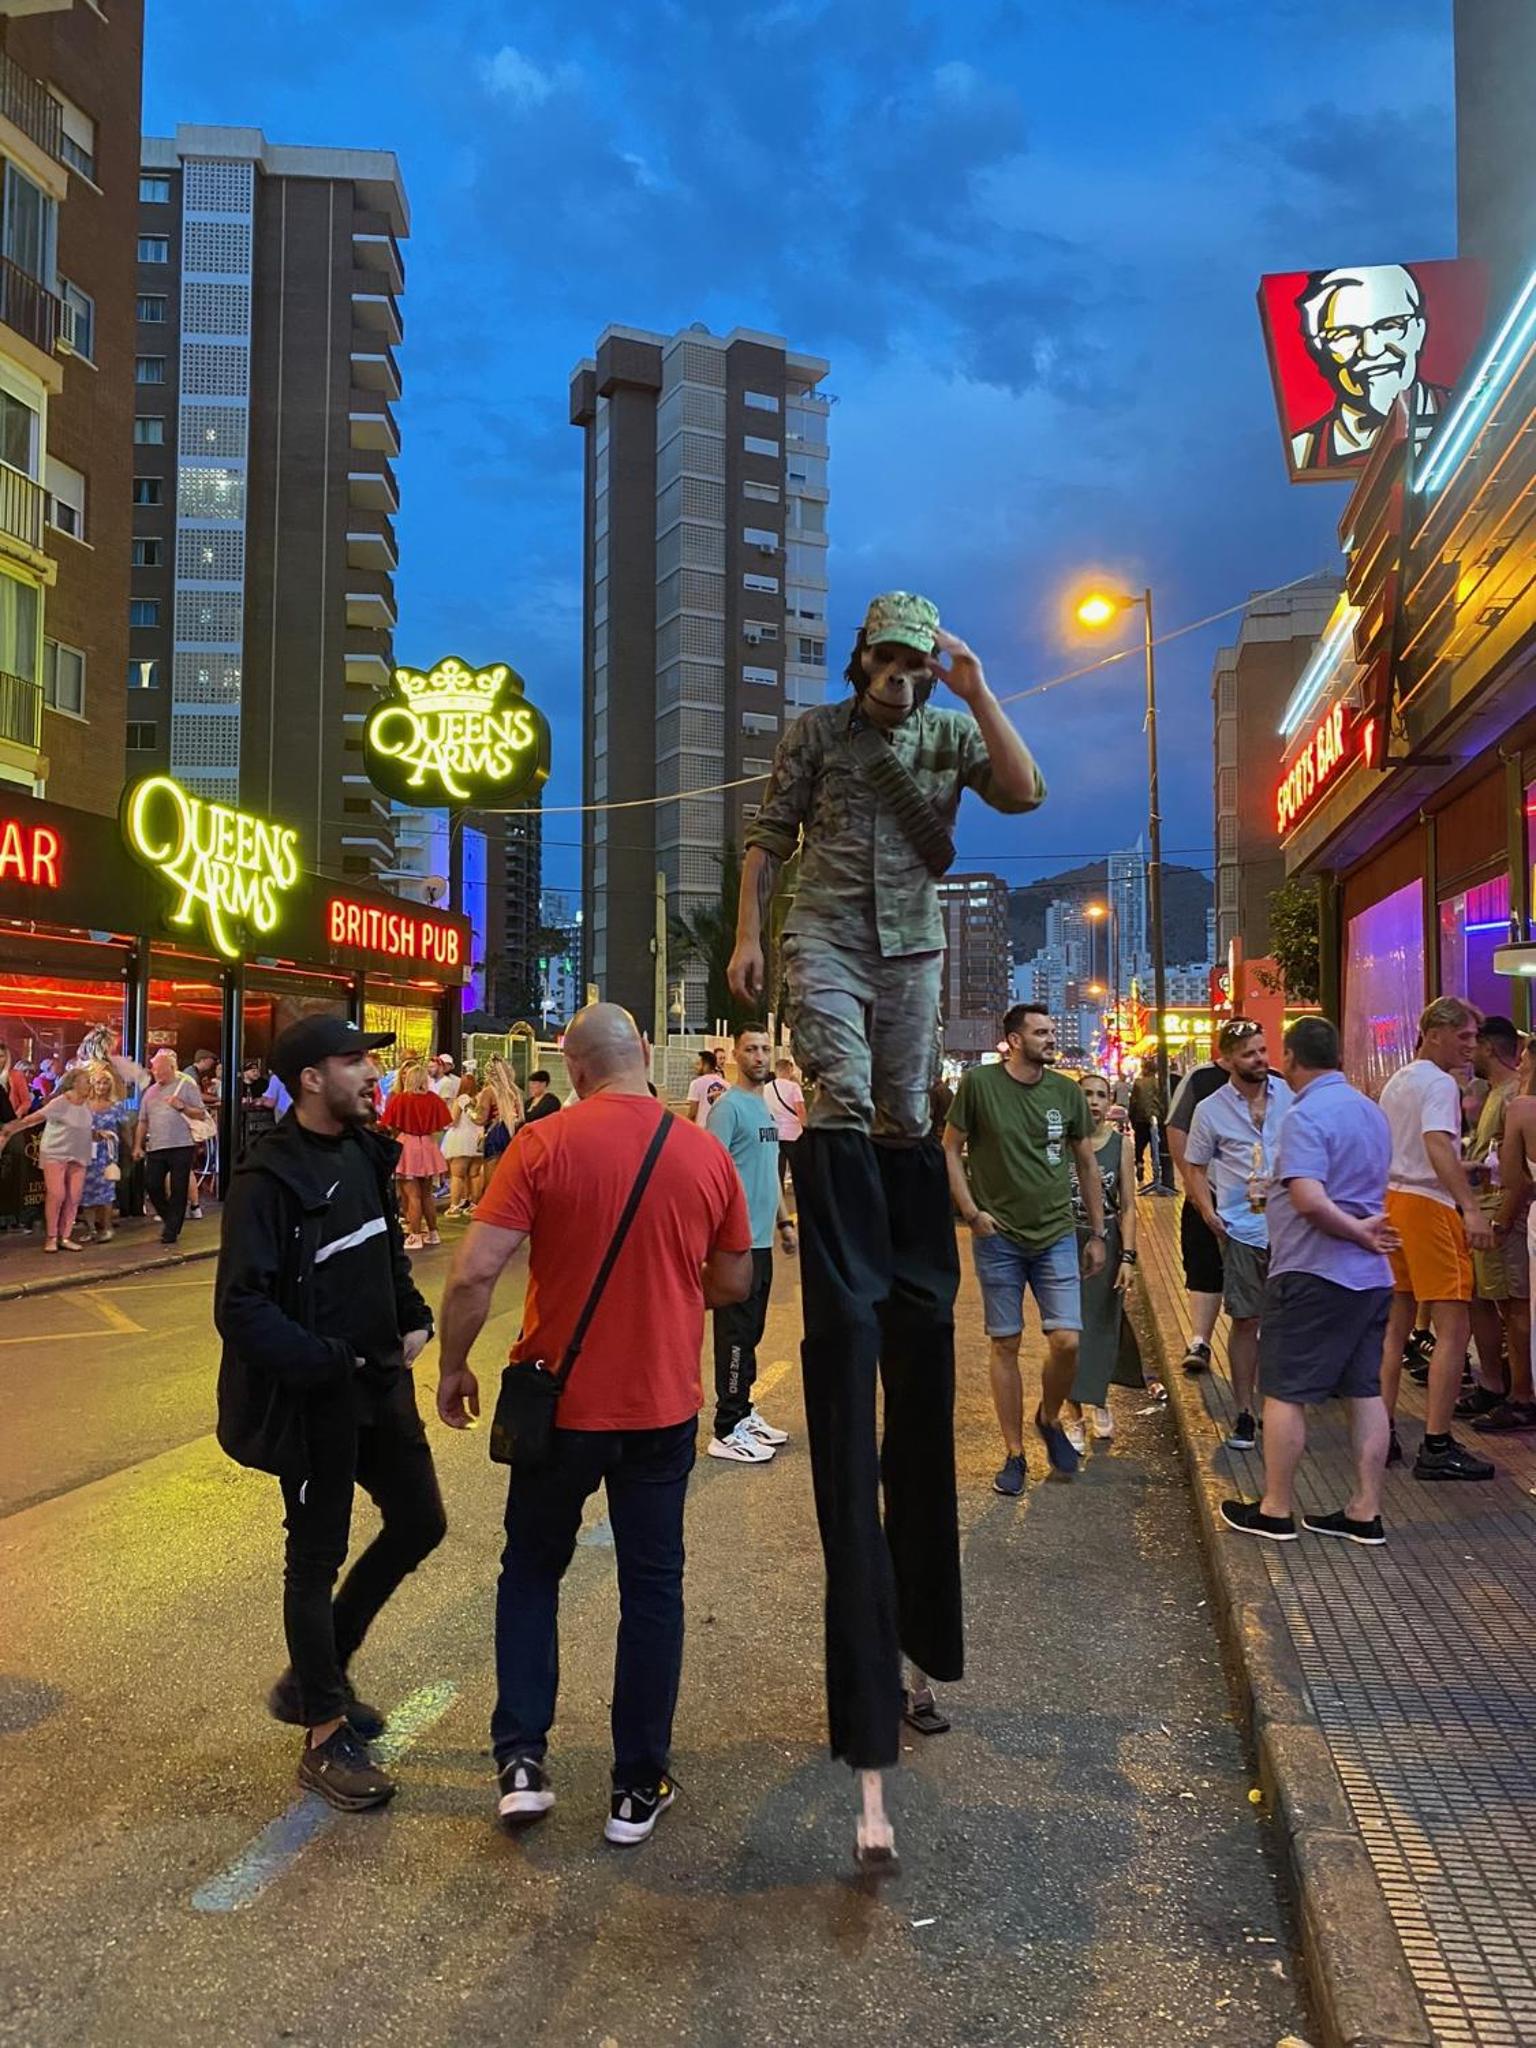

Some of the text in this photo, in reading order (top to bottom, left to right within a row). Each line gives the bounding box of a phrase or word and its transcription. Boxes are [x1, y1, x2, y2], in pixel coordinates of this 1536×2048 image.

[370, 707, 533, 755] QUEENS
[406, 742, 513, 798] ARMS
[1277, 700, 1344, 834] SPORTS BAR
[133, 777, 297, 890] QUEENS
[169, 853, 276, 957] ARMS
[331, 900, 459, 965] BRITISH PUB
